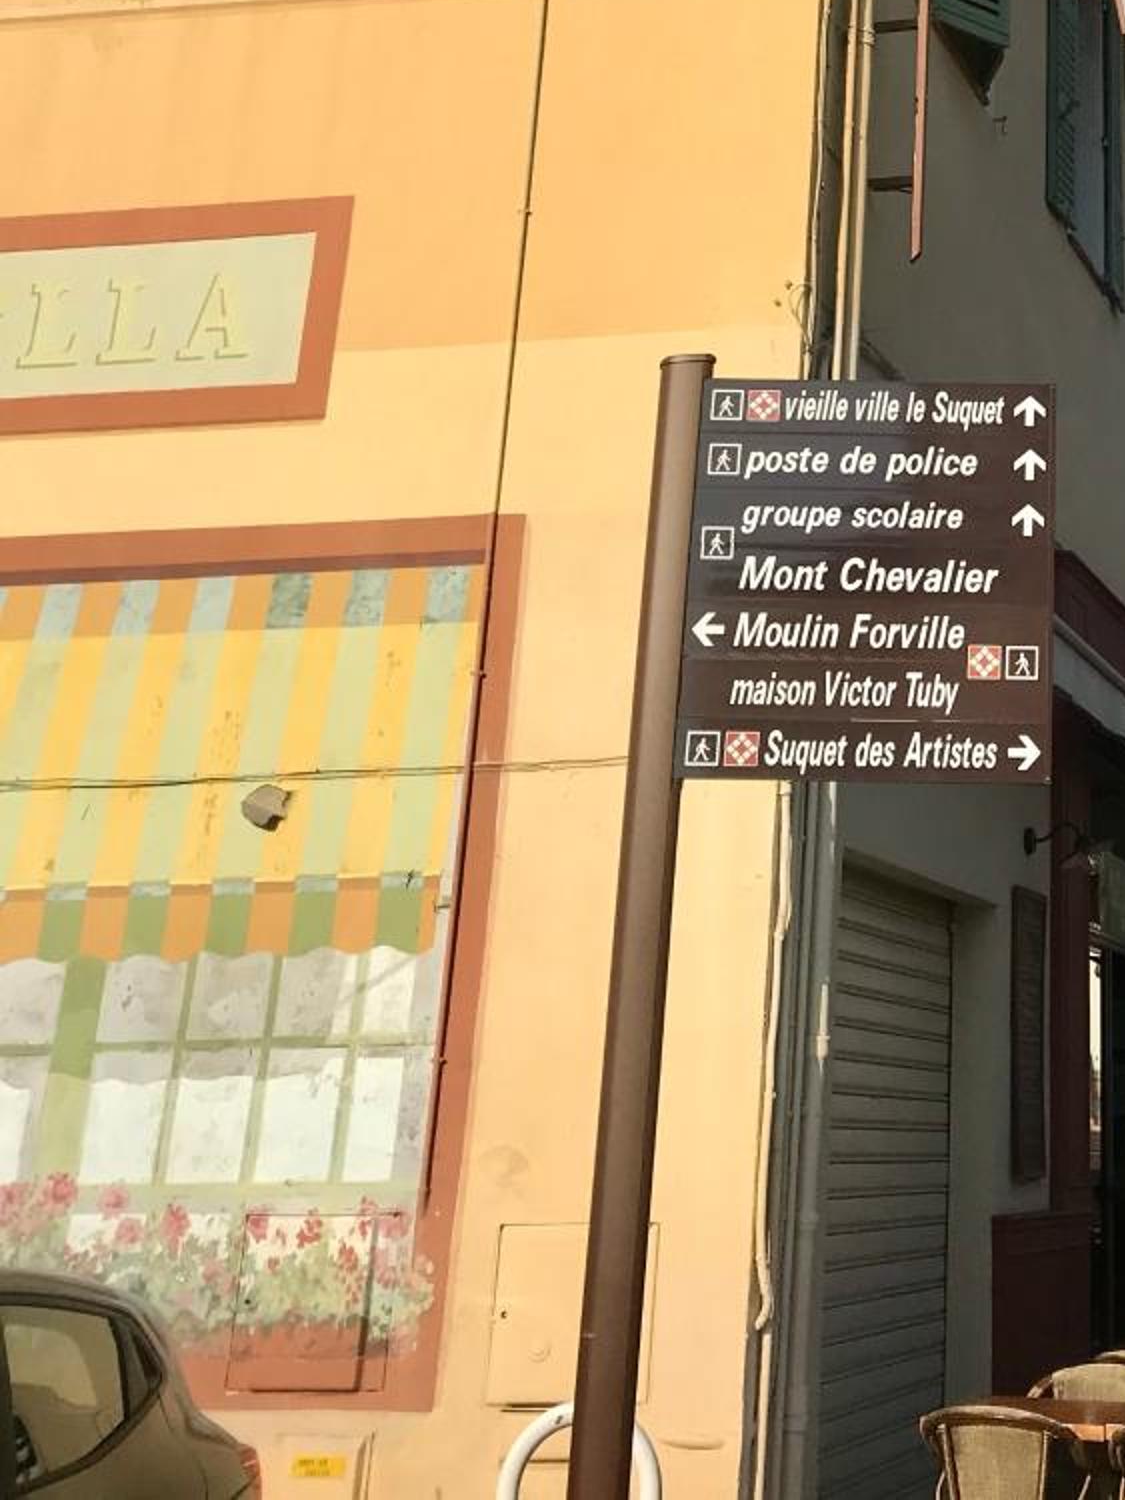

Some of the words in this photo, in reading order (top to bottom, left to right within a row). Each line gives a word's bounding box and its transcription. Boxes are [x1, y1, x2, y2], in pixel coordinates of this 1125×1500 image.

[0, 272, 250, 370] LLA
[783, 389, 849, 422] vieille
[855, 390, 900, 423] ville
[905, 391, 926, 423] le
[931, 391, 1005, 432] Suquet
[743, 447, 830, 480] poste
[839, 446, 877, 475] de
[885, 446, 978, 482] police
[740, 505, 842, 535] groupe
[851, 500, 964, 529] scolaire
[739, 555, 829, 592] Mont
[840, 557, 1000, 594] Chevalier
[733, 612, 839, 649] Moulin
[849, 614, 966, 649] Forville
[729, 671, 817, 707] maison
[824, 670, 897, 707] Victor
[905, 671, 960, 715] Tuby
[764, 729, 848, 775] Suquet
[855, 732, 896, 768] des
[903, 731, 998, 770] Artistes
